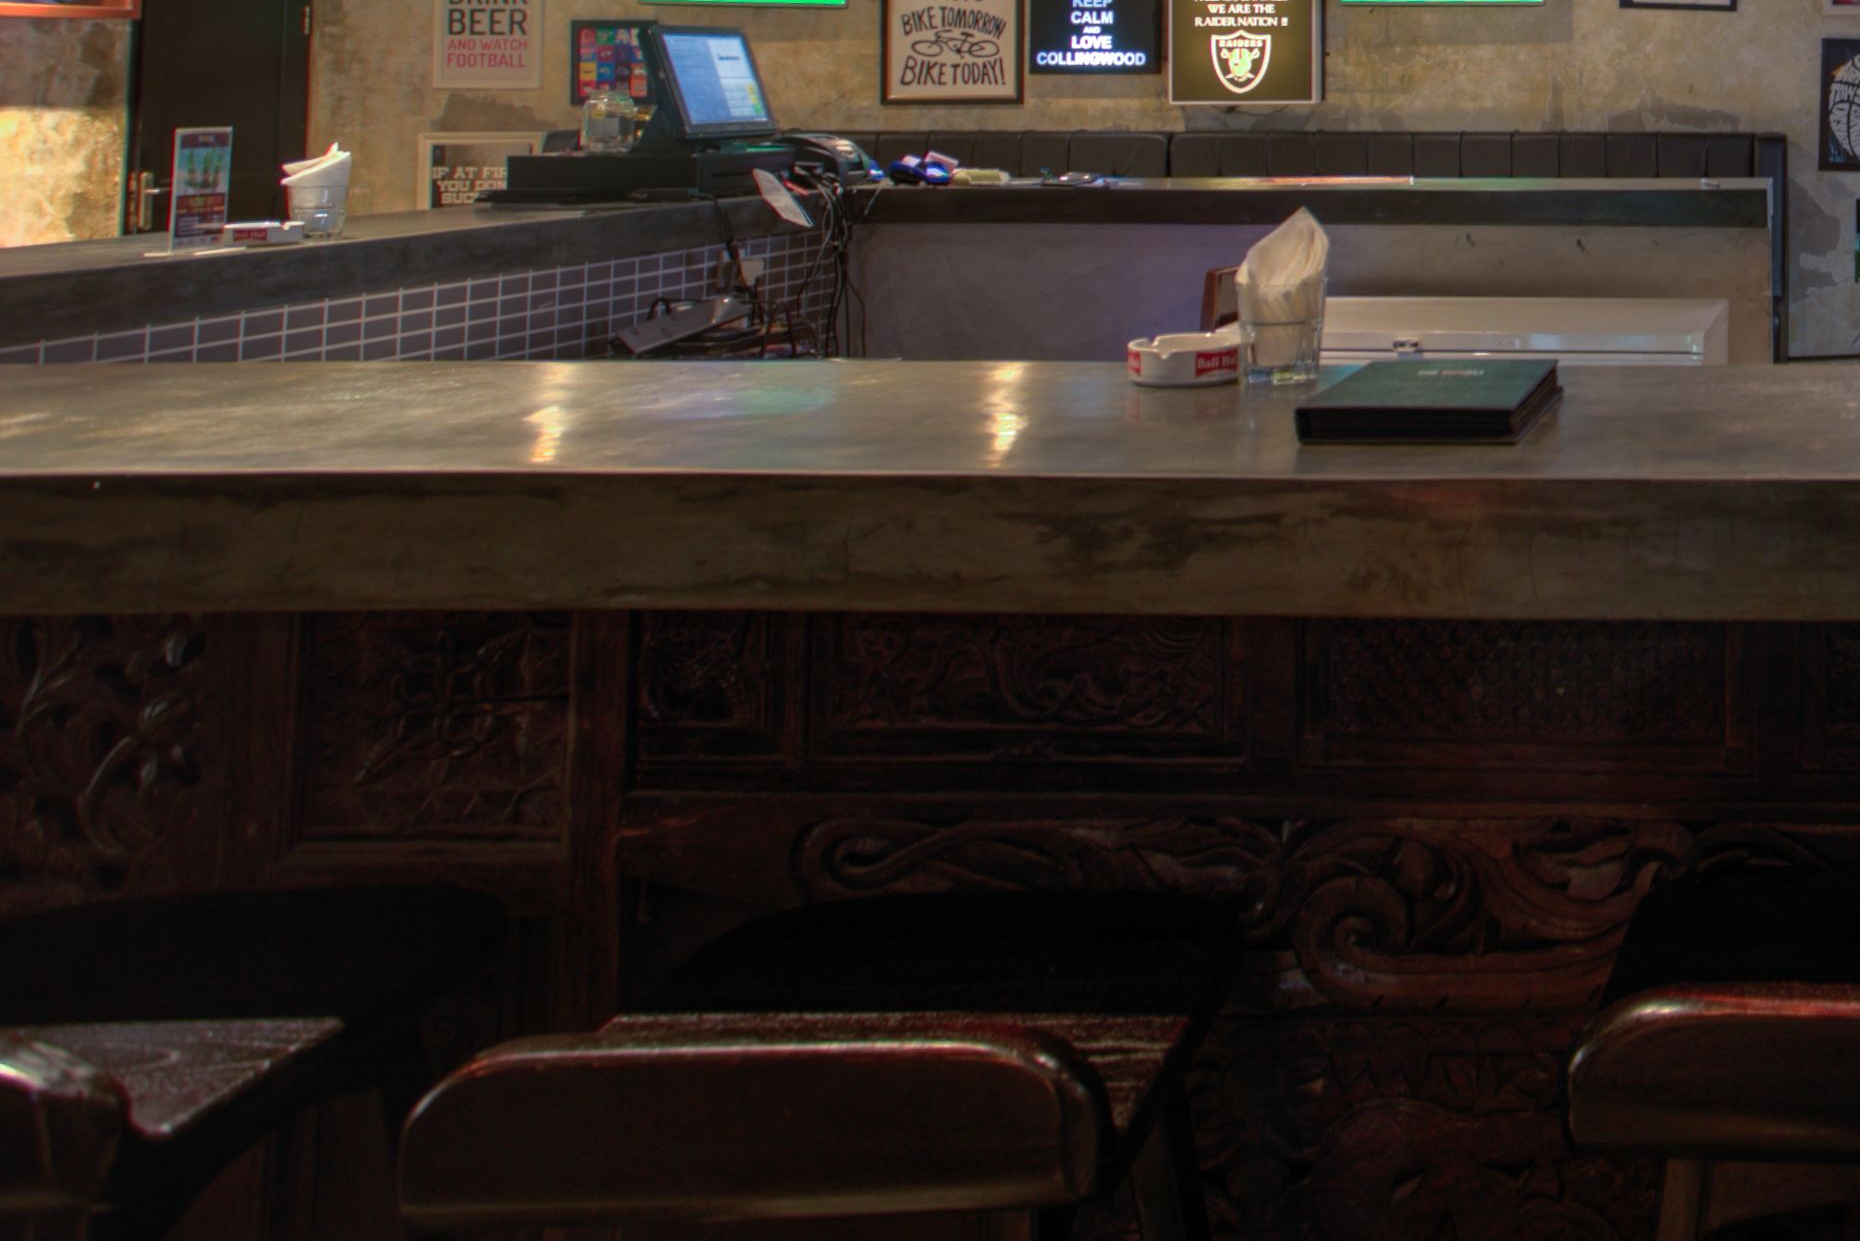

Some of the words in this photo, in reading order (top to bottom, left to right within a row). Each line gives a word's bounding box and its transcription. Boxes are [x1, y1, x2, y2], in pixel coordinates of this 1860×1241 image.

[1207, 4, 1226, 14] WE
[1228, 4, 1251, 14] ARE
[1253, 4, 1275, 14] THE
[448, 8, 528, 35] BEER
[901, 6, 937, 36] BIKE
[1071, 11, 1114, 24] CALM
[1195, 17, 1237, 26] RAIDER
[1238, 17, 1277, 26] NATION
[1083, 26, 1101, 34] AND
[448, 39, 476, 50] AND
[479, 39, 528, 50] WATCH
[1071, 36, 1112, 49] LOVE
[447, 53, 527, 68] FOOTBALL
[1037, 52, 1146, 65] COLLINGWOOD
[900, 55, 947, 86] BIKE
[951, 56, 1006, 86] TODAY!
[433, 166, 450, 179] IF
[454, 166, 477, 179] AT
[437, 180, 471, 191] YOU
